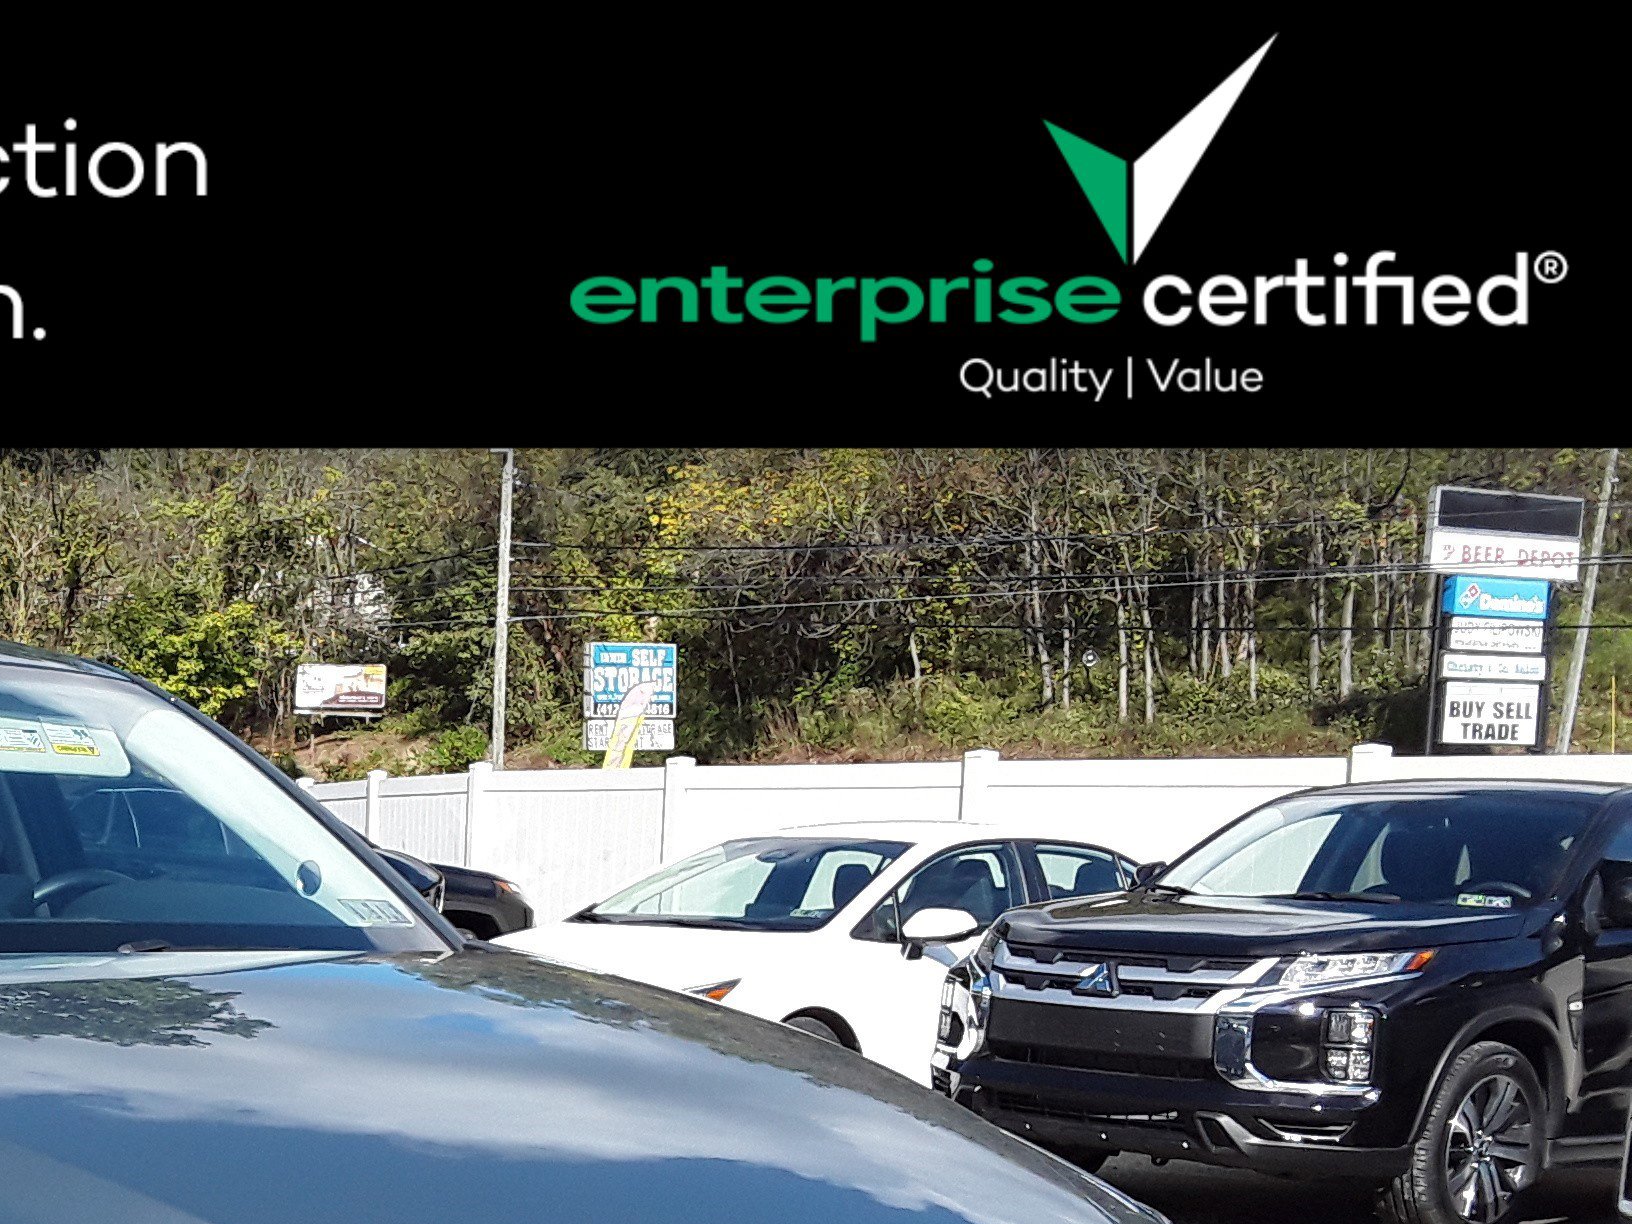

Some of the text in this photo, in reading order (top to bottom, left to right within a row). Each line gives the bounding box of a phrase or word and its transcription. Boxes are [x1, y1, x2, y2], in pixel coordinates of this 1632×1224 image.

[1462, 545, 1505, 564] BEER
[1517, 549, 1574, 568] DEPOT
[632, 649, 666, 666] SELF
[593, 667, 673, 692] STORAGE
[1448, 701, 1532, 719] BUY SELL
[1461, 723, 1519, 740] TRADE
